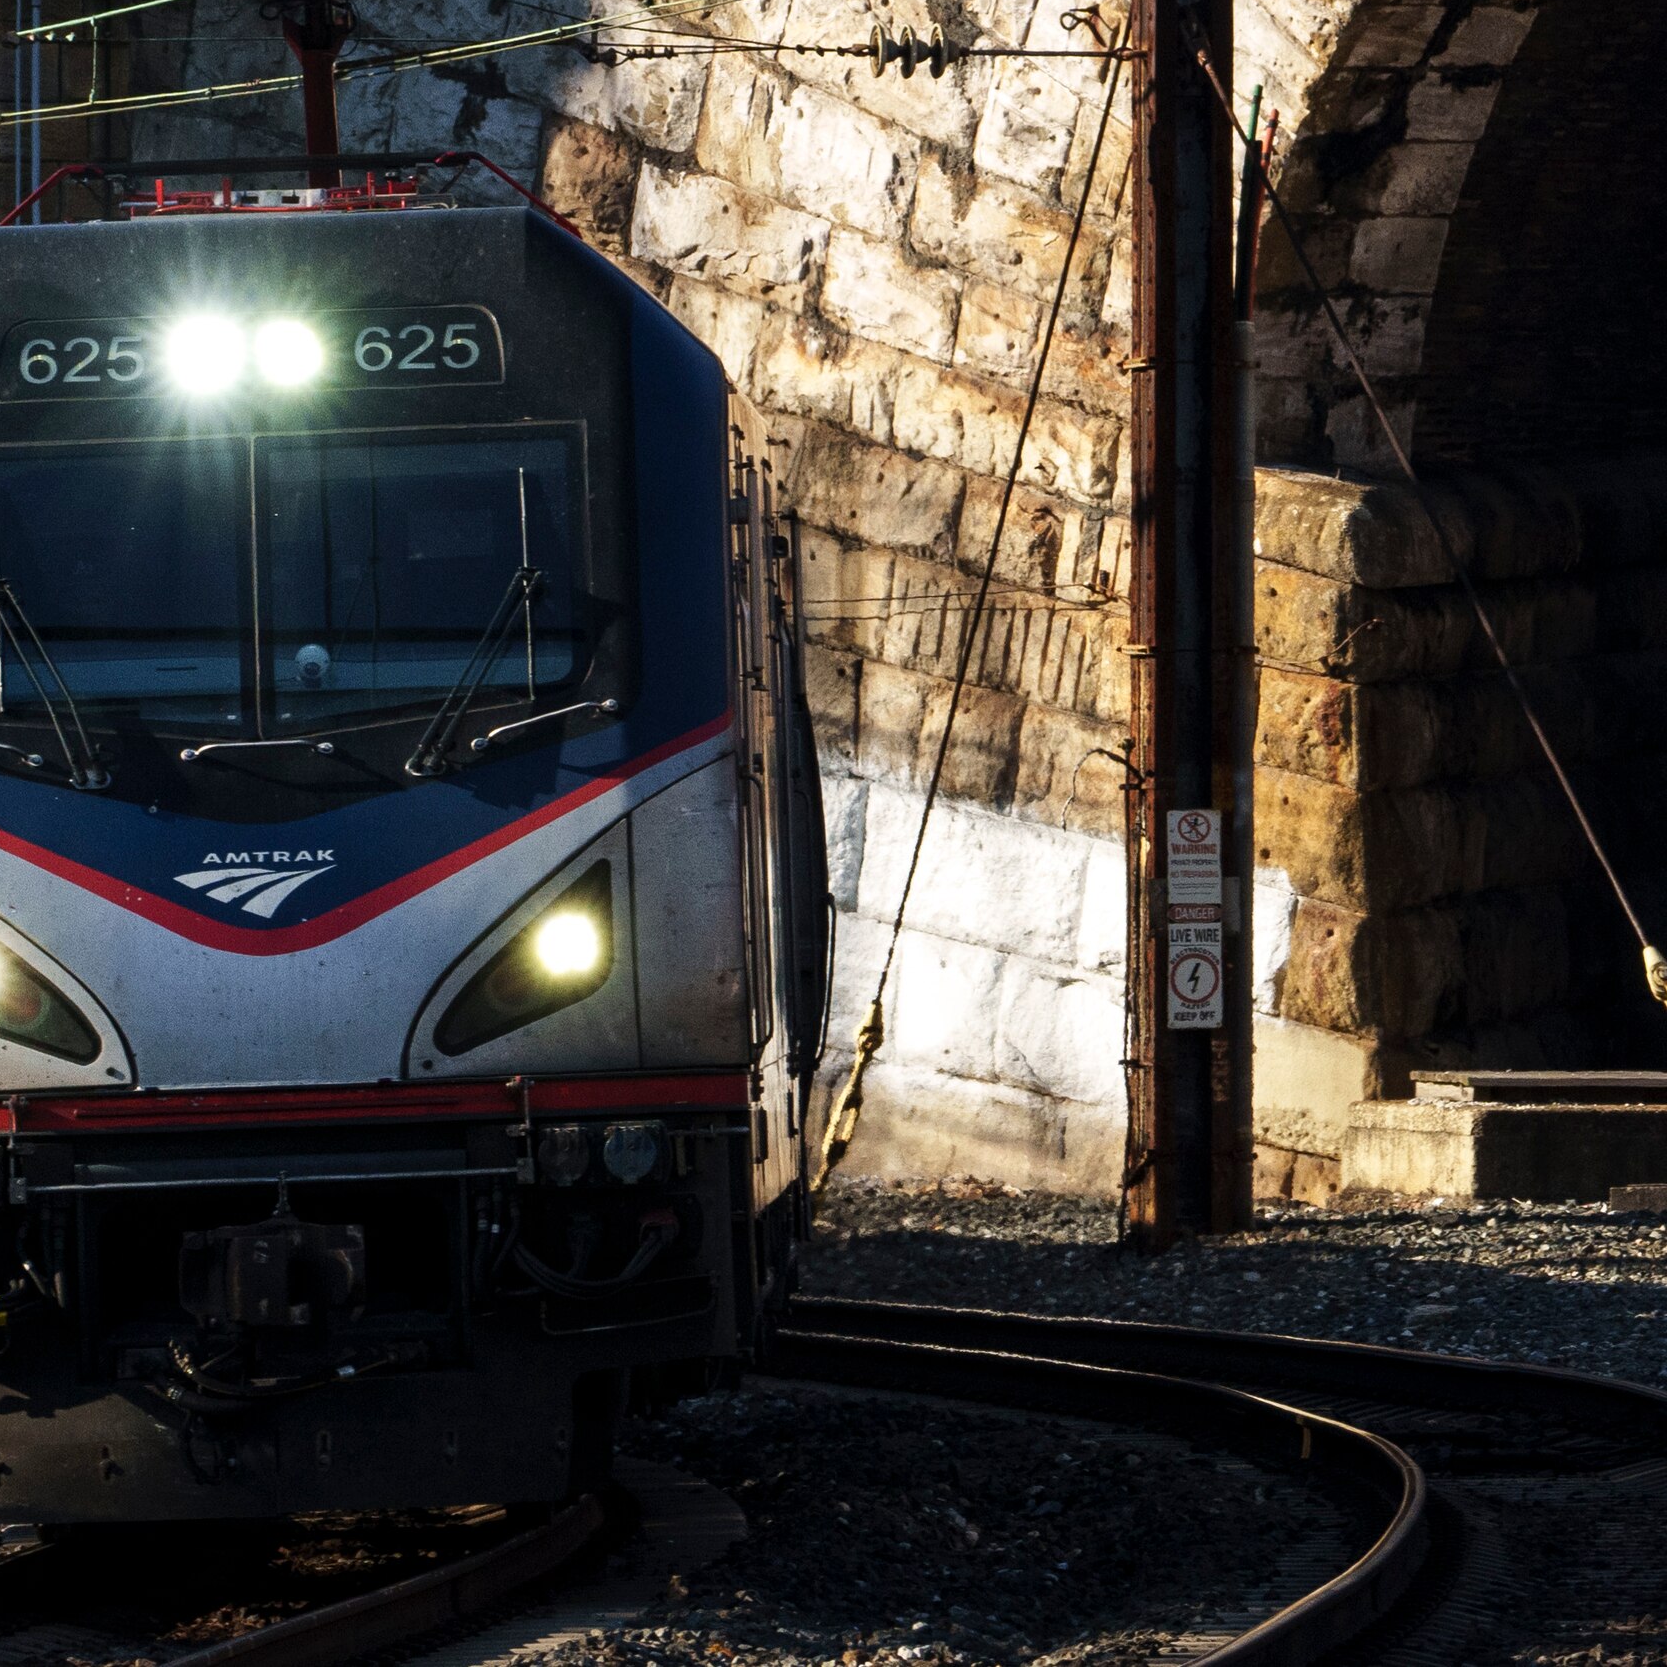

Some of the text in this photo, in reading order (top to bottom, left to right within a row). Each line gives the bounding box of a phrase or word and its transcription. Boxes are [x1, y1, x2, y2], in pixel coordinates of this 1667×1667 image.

[354, 323, 480, 372] 625
[19, 335, 146, 385] 625
[202, 848, 335, 864] AMTRAK
[1170, 843, 1217, 855] WARNING
[1174, 906, 1215, 920] DANGER
[1170, 928, 1220, 943] LIVE WIRE
[1173, 1010, 1216, 1022] KEEP OFF
